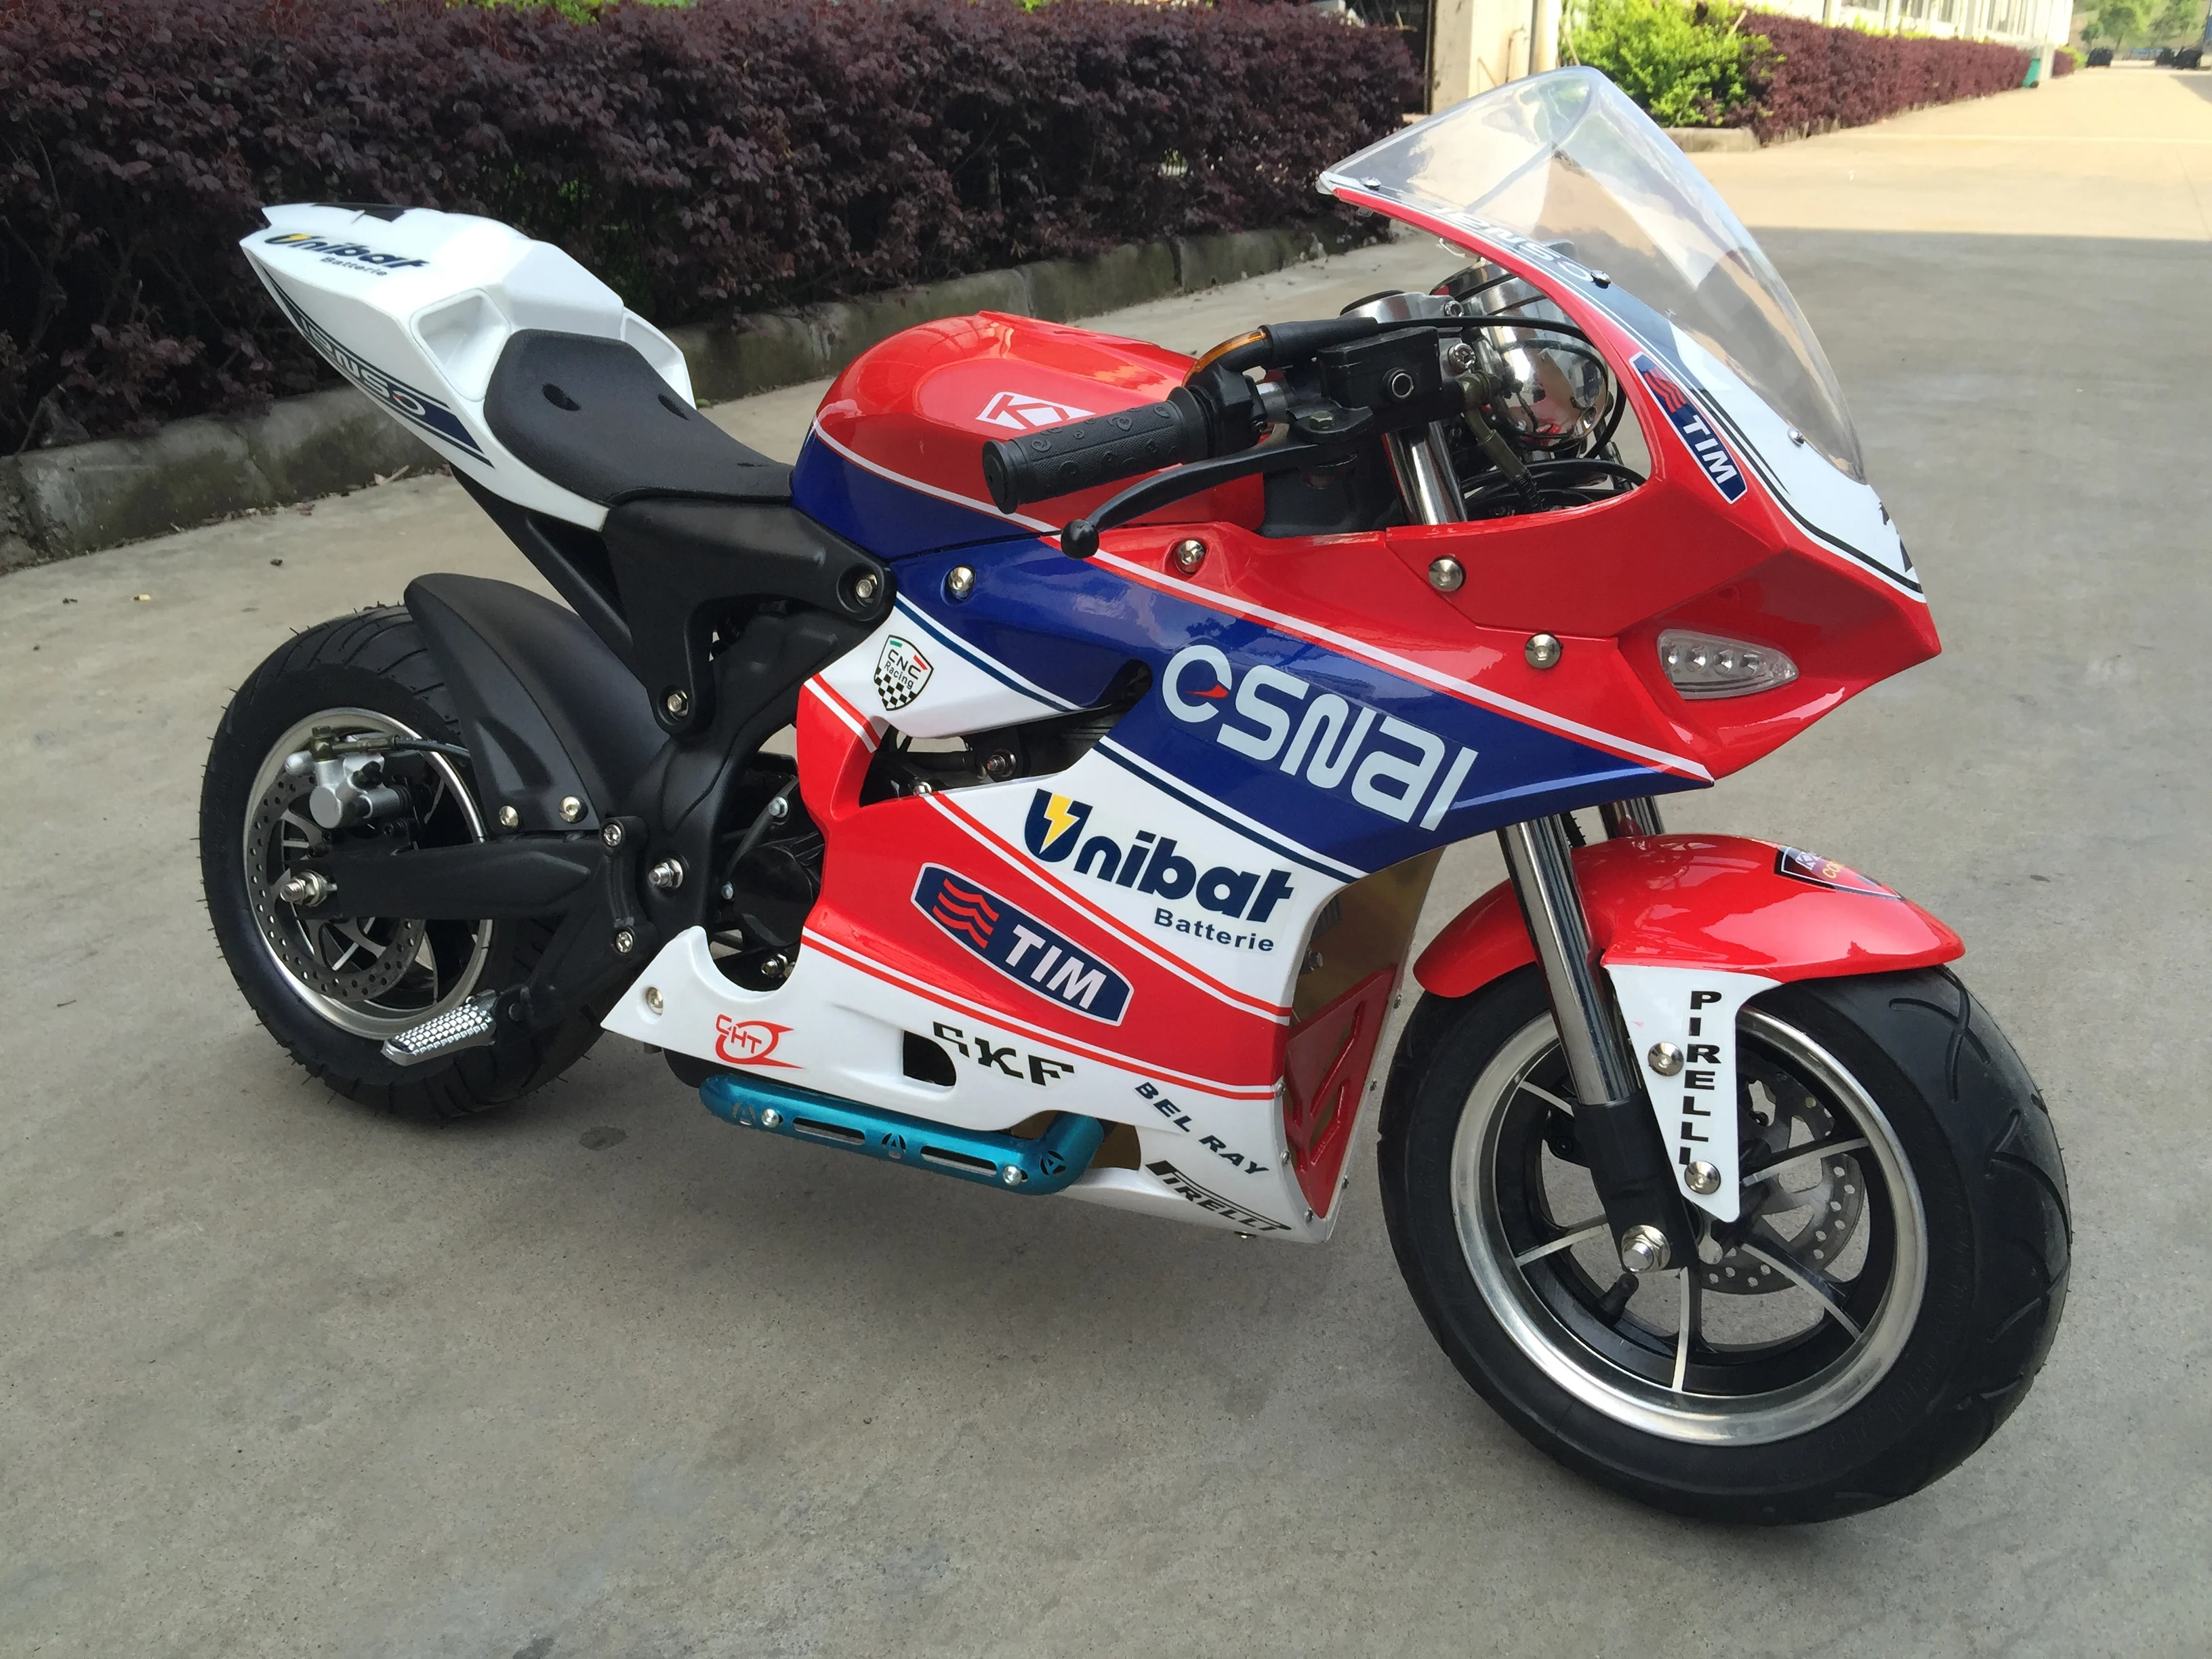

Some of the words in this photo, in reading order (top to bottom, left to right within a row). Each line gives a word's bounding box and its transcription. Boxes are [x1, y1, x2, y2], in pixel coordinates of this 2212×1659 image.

[264, 233, 430, 268] Unibat
[321, 257, 388, 276] Batterie
[1683, 415, 1738, 485] TIM
[884, 660, 914, 691] Racing
[887, 649, 922, 680] CNC
[1024, 787, 1295, 923] Unibat
[1153, 907, 1274, 952] Batterie
[1004, 923, 1107, 1010] TIM
[1679, 990, 1723, 1166] PIRELLI
[1134, 1081, 1191, 1133] BEL
[1198, 1134, 1269, 1174] RAY
